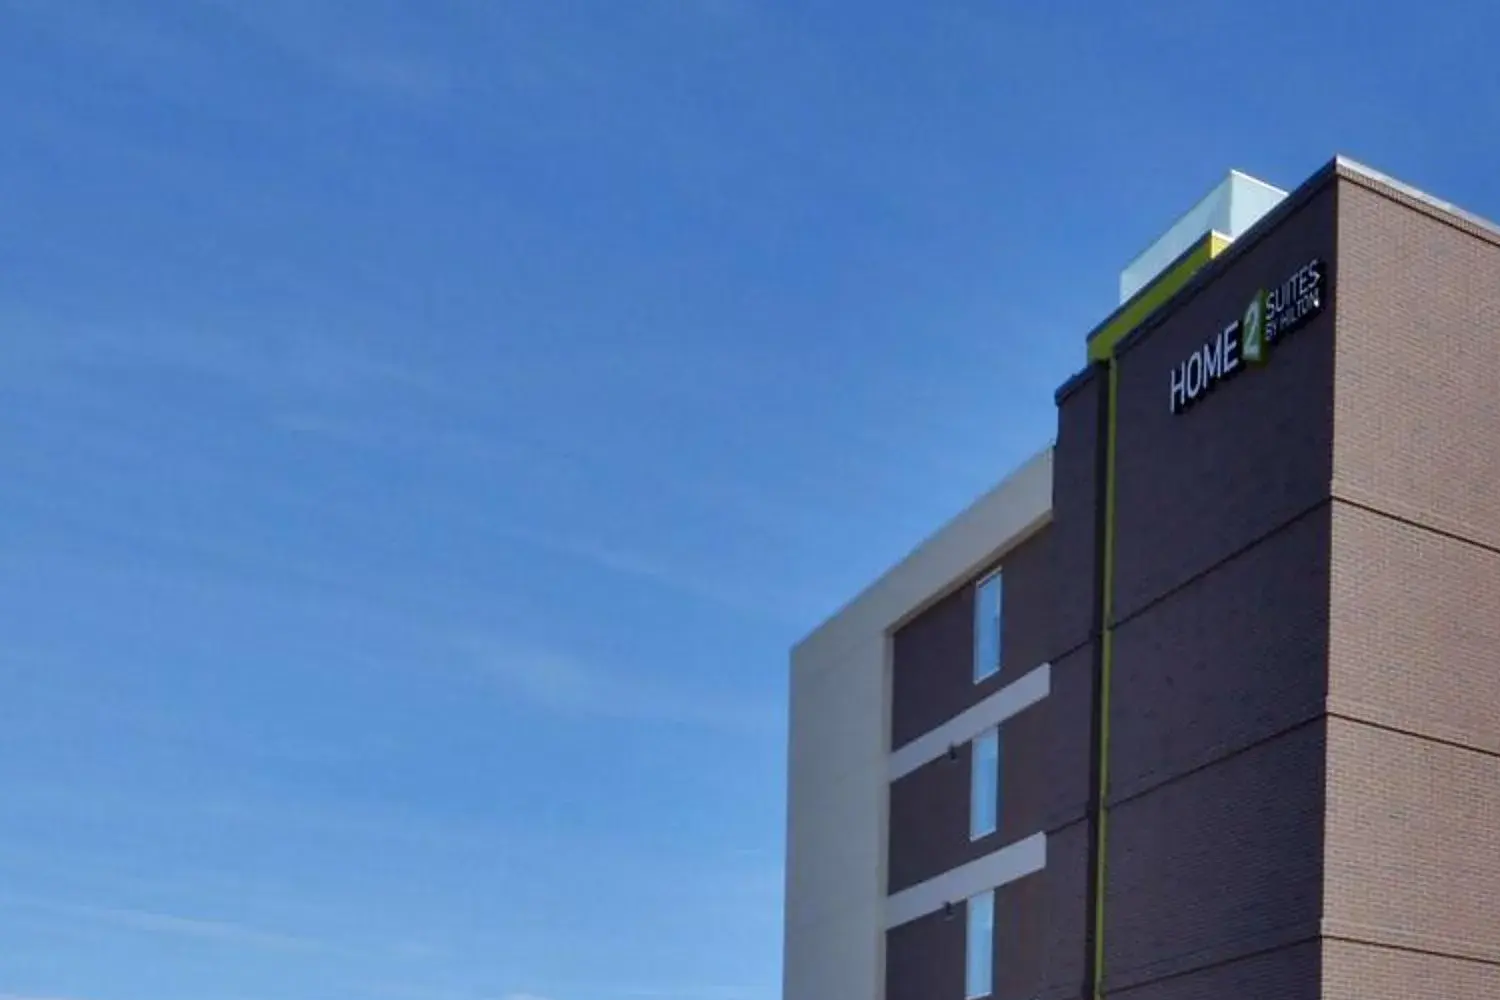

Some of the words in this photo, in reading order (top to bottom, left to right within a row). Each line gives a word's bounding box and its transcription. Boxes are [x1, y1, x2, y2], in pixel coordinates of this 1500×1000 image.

[1265, 259, 1320, 320] SUITES
[1169, 320, 1239, 413] HOME
[1244, 298, 1260, 358] 2
